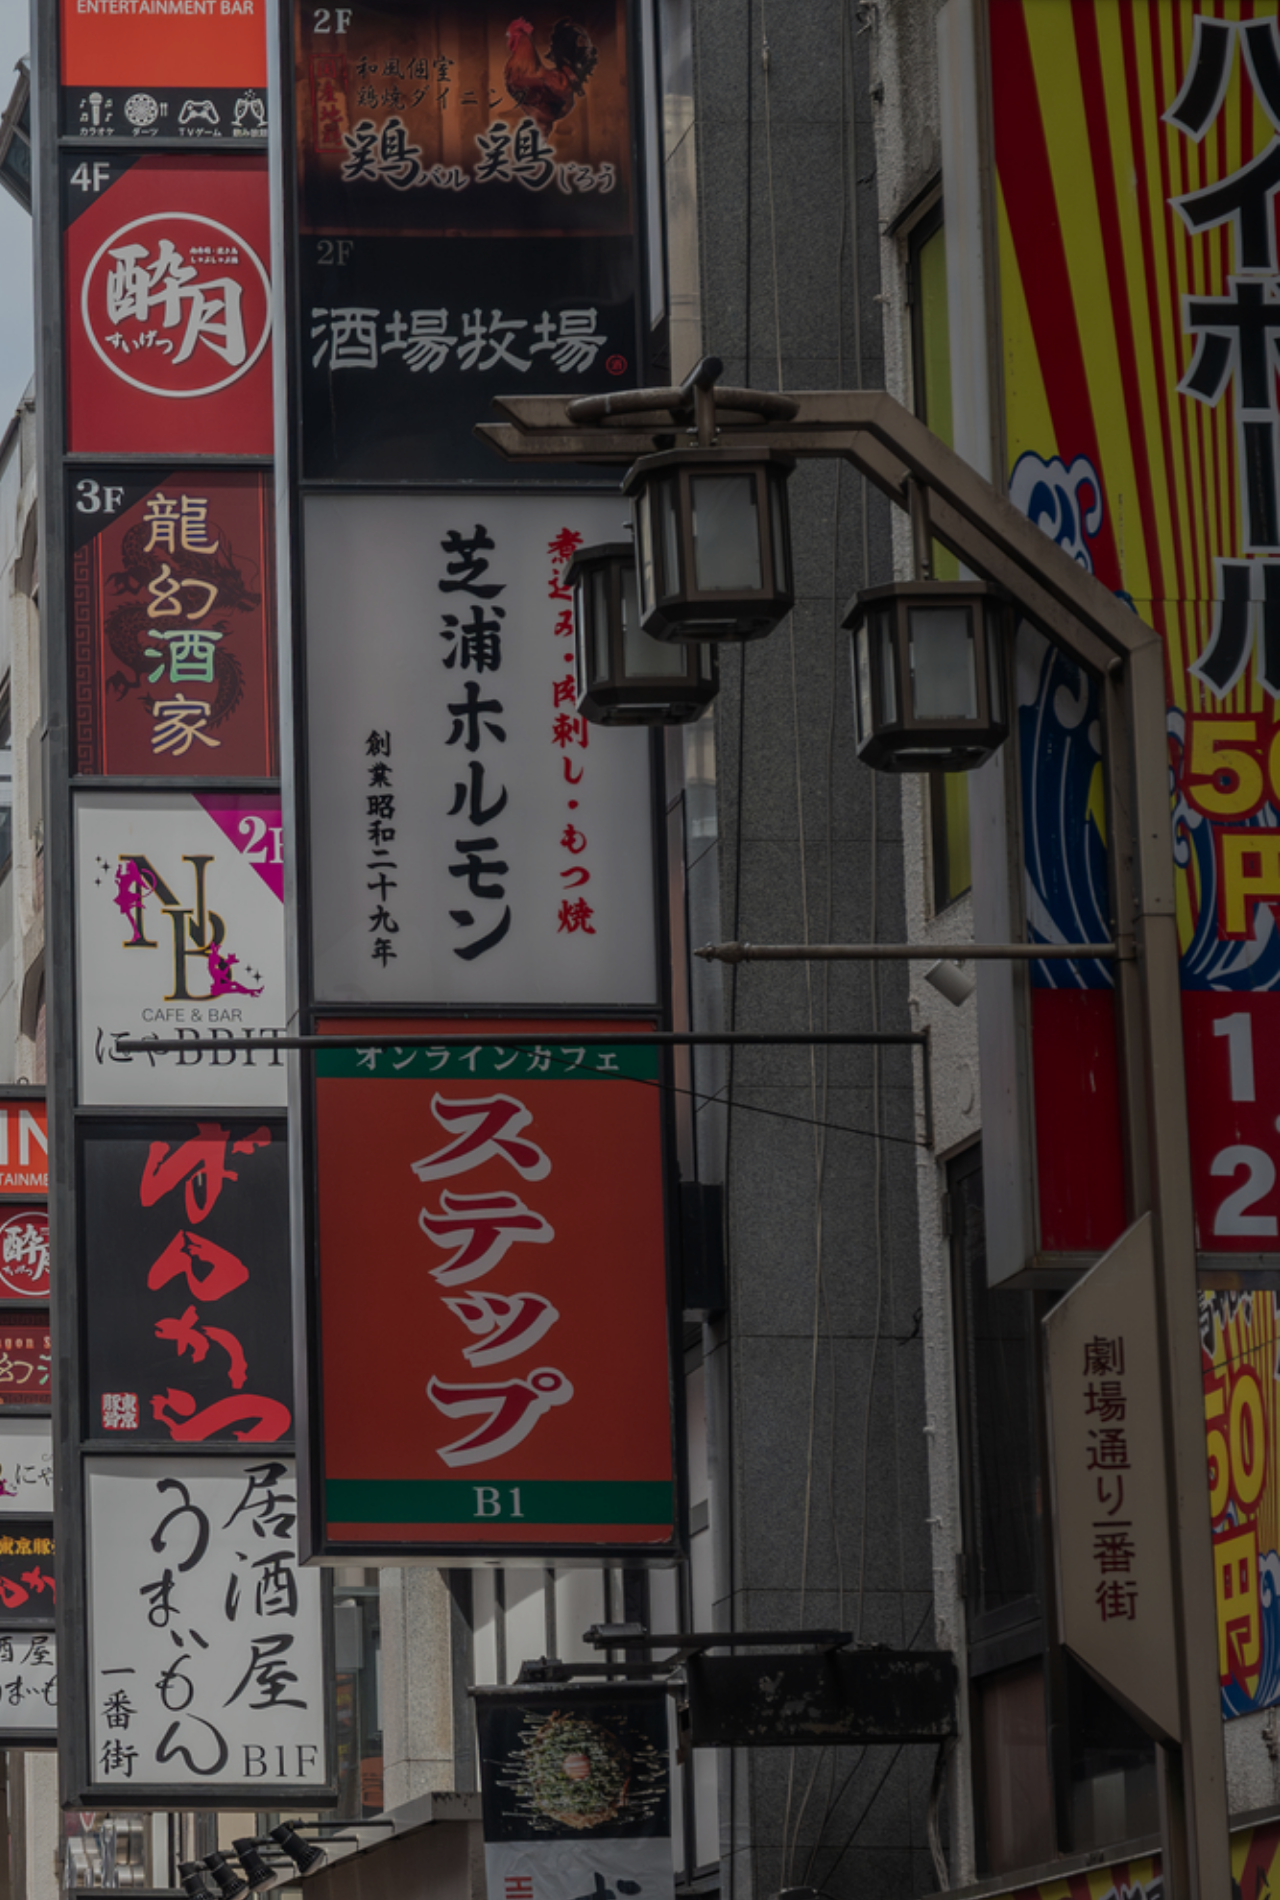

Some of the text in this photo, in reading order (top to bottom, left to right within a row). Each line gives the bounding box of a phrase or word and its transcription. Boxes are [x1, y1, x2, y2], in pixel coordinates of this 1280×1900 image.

[312, 8, 354, 35] 2F
[355, 55, 456, 82] 和風個室
[78, 127, 116, 137] カラオケ
[131, 127, 160, 137] ダーツ
[69, 161, 111, 193] 4F
[316, 239, 354, 267] 2F
[105, 238, 248, 367] 酔月
[104, 330, 174, 357] すいげつ
[309, 306, 608, 374] 酒場牧場
[74, 479, 125, 514] 3F
[142, 490, 224, 759] 龍幻酒家
[437, 522, 513, 962] 芝浦ホルモン
[364, 728, 401, 969] 創業昭和二十九年
[141, 1007, 243, 1023] CAFE & BAR
[354, 1044, 621, 1074] オンラインカフェ
[409, 1089, 574, 1469] ステップ
[1082, 1334, 1140, 1623] 劇場通り一番街
[472, 1486, 526, 1519] B1
[221, 1461, 308, 1710] 居酒屋
[140, 1477, 230, 1776] うまいもん
[99, 1666, 140, 1777] 一番街
[242, 1744, 319, 1778] B1F
